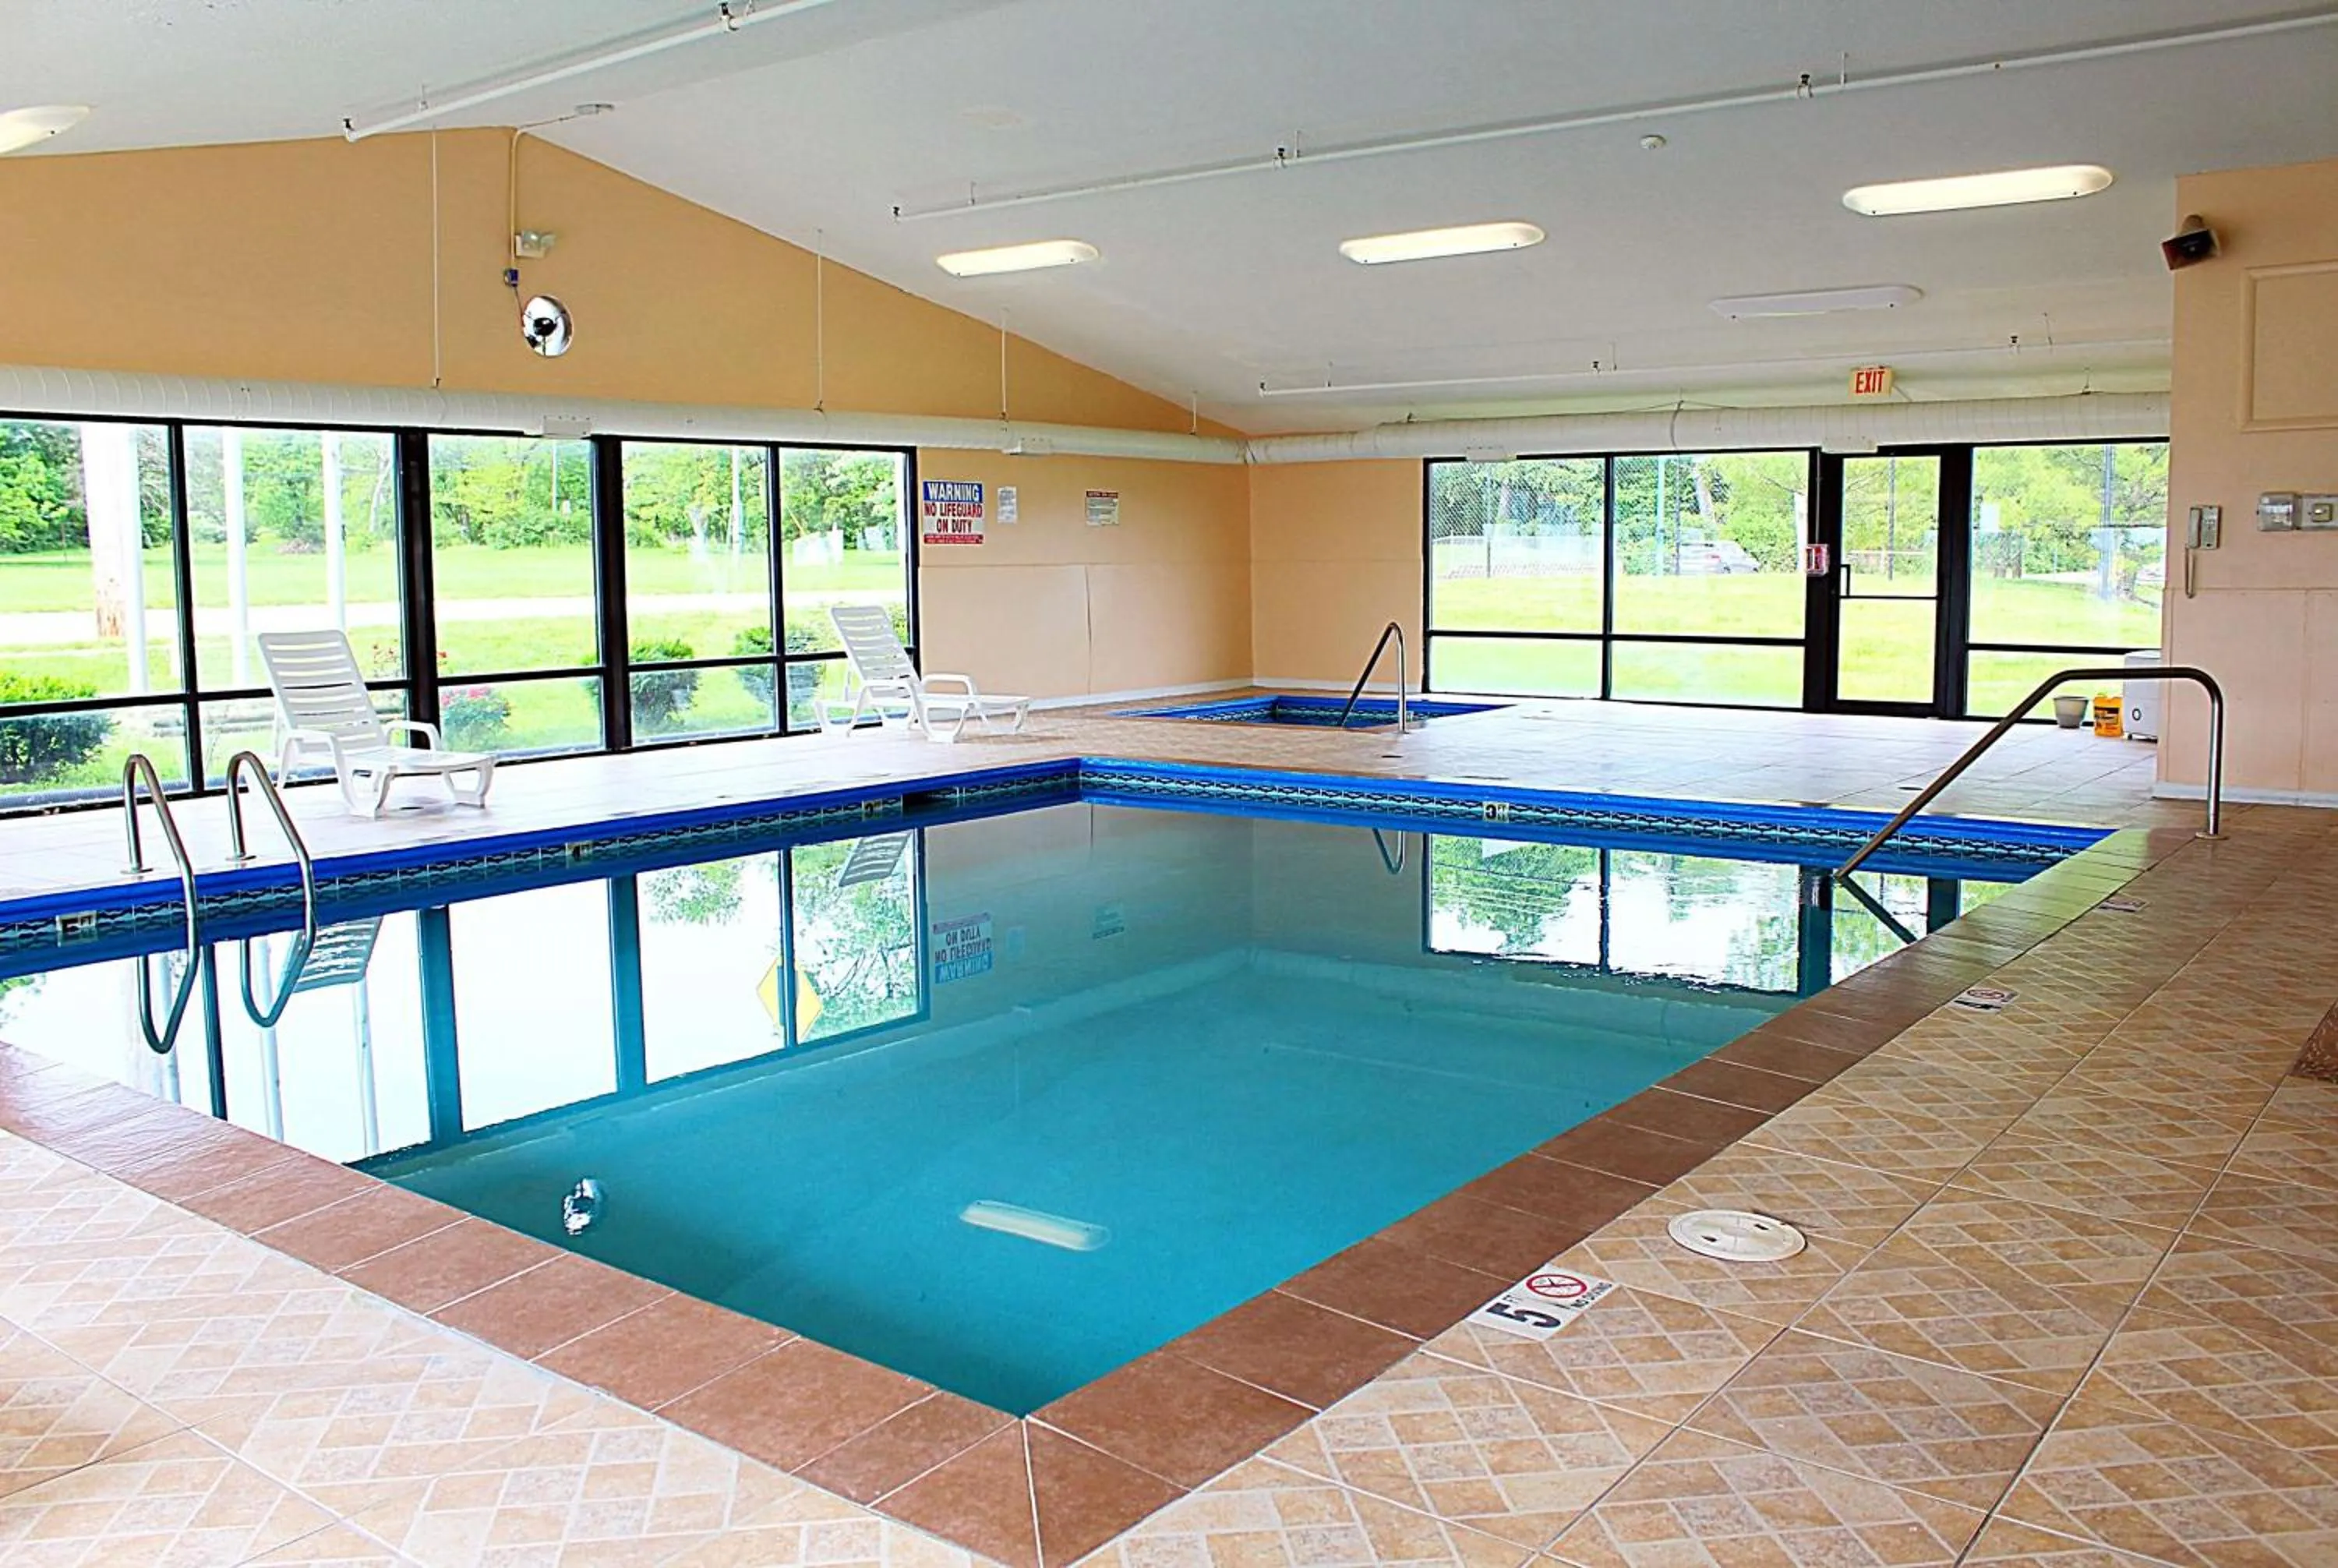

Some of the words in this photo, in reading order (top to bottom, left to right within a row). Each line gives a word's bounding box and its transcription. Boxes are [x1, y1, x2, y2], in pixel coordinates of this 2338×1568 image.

[1856, 371, 1885, 394] EXIT
[927, 483, 980, 502] WARNING
[924, 503, 937, 516] NO
[940, 503, 983, 517] LIFEGUARD
[937, 518, 948, 532] ON
[952, 519, 972, 533] DUTY
[1485, 1301, 1561, 1329] 5
